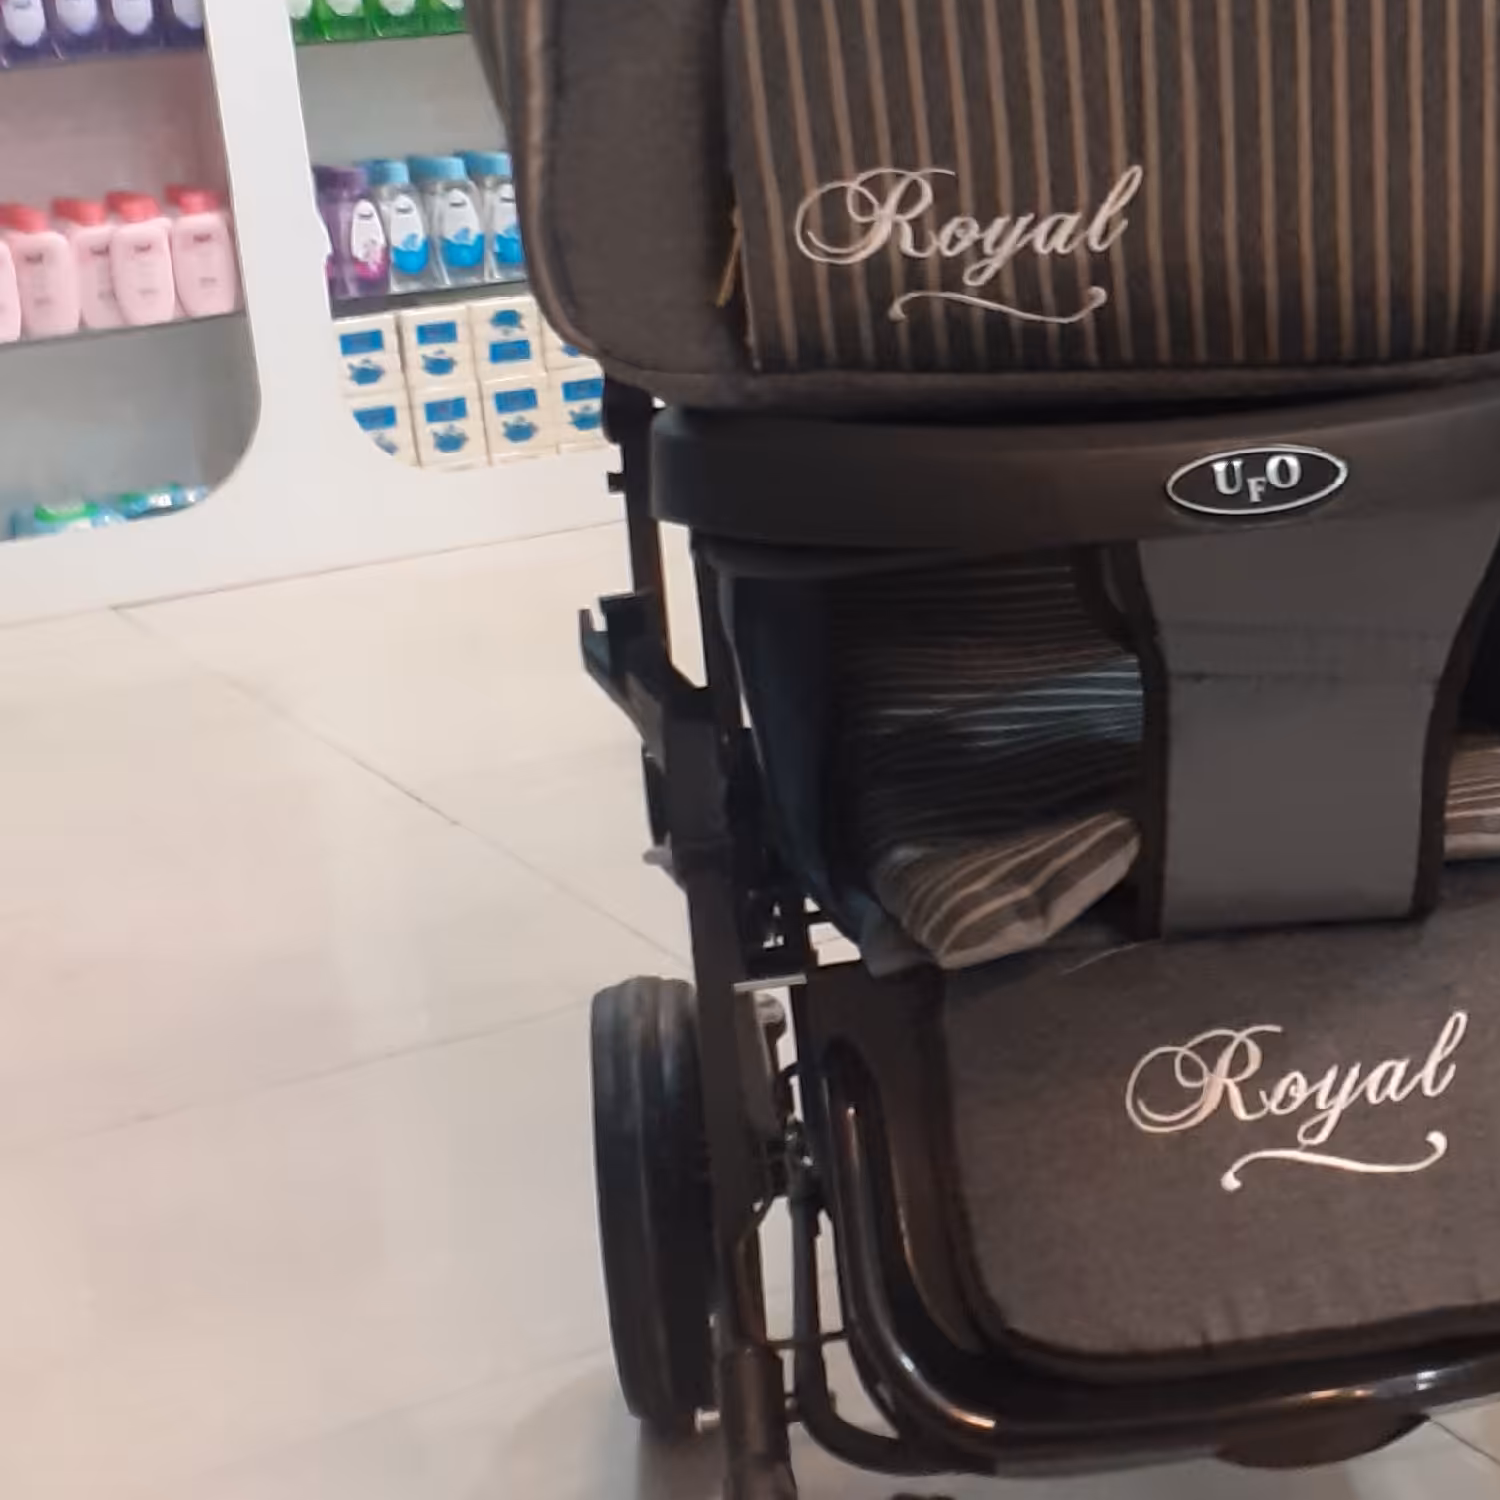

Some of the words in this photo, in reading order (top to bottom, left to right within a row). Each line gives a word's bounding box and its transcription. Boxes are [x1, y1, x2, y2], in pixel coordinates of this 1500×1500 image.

[795, 163, 1144, 287] Royal
[1212, 453, 1302, 503] UFO
[1125, 1009, 1470, 1147] Royal
